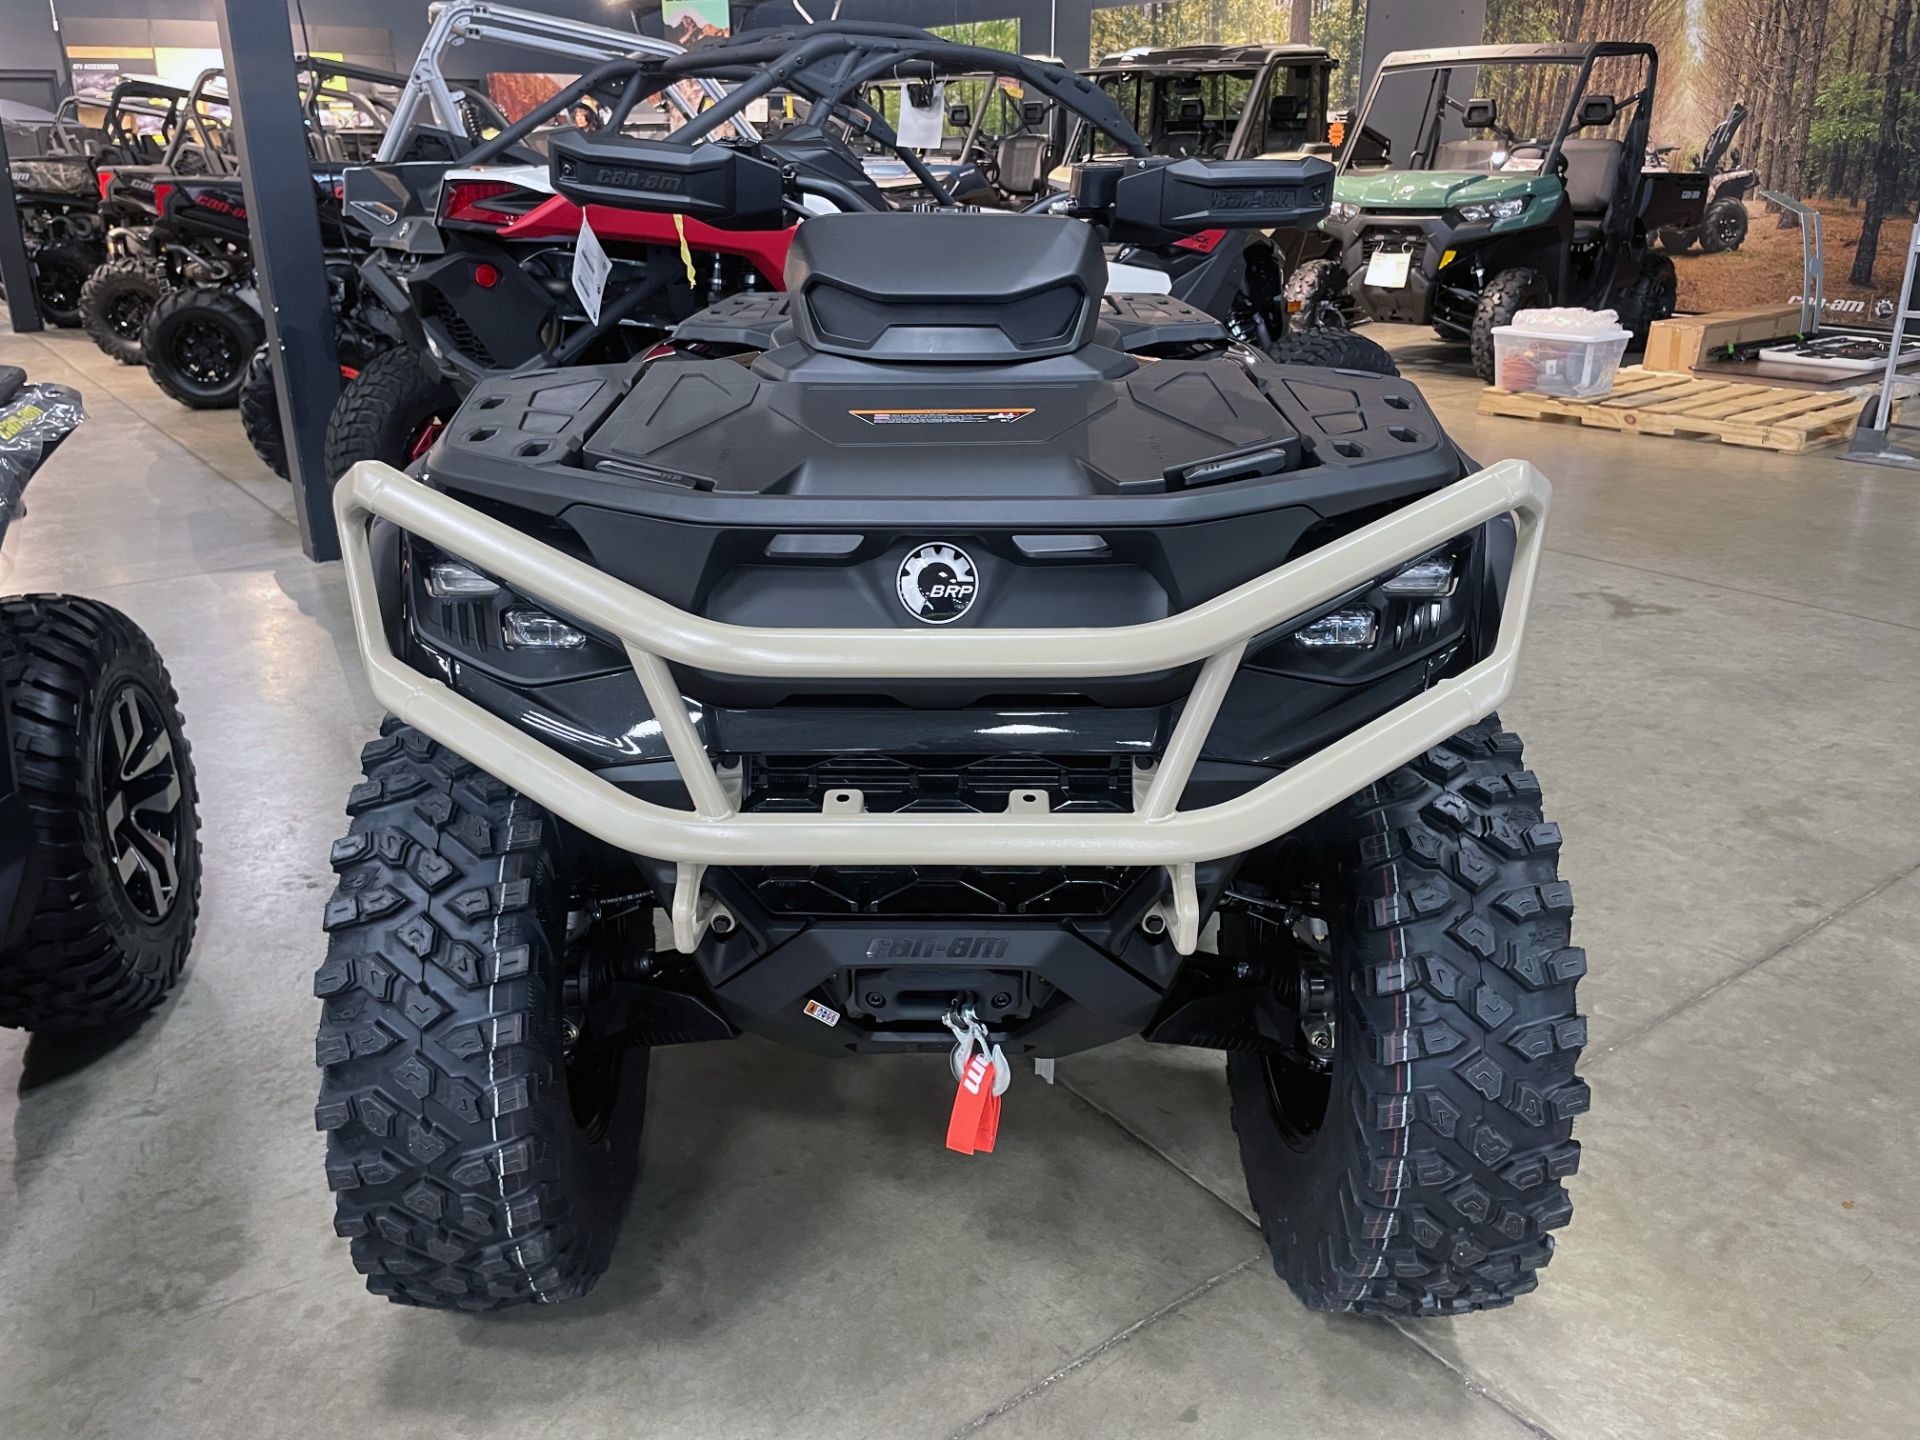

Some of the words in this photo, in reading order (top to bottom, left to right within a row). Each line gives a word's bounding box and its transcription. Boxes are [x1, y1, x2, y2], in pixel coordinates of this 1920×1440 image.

[594, 168, 682, 193] can-am
[930, 585, 973, 597] BRP
[865, 937, 1009, 958] can-am
